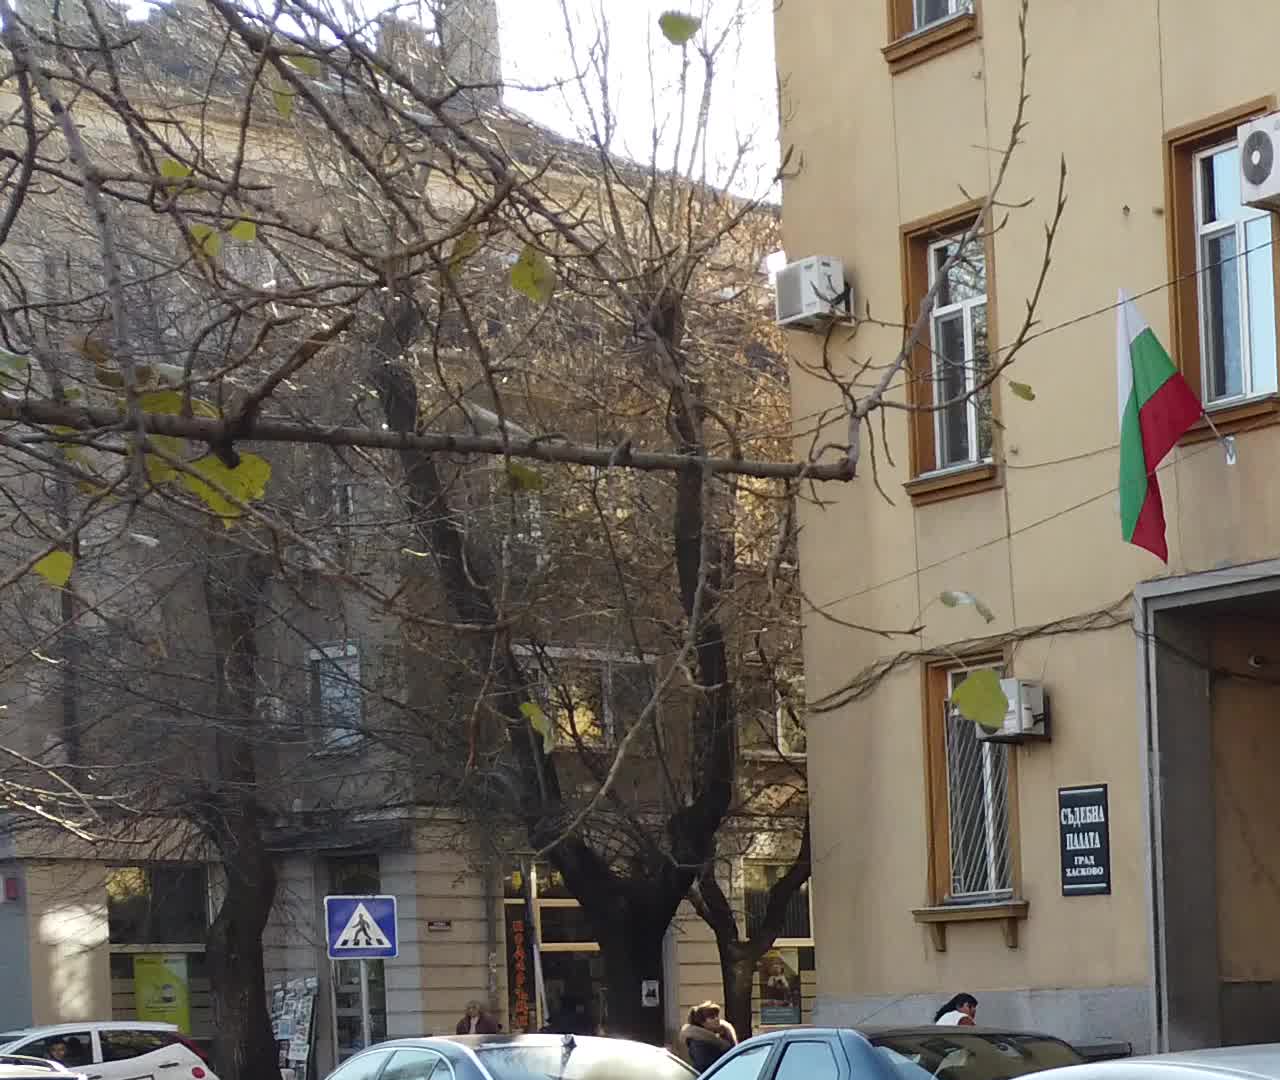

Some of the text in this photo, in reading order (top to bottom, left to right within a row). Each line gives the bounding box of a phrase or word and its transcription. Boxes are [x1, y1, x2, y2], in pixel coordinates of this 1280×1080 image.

[1061, 805, 1105, 828] СЪДЕБНА
[1066, 831, 1101, 850] ПАЛАТА
[1074, 855, 1096, 866] ГРАД
[1065, 866, 1104, 877] ХАСКОВО
